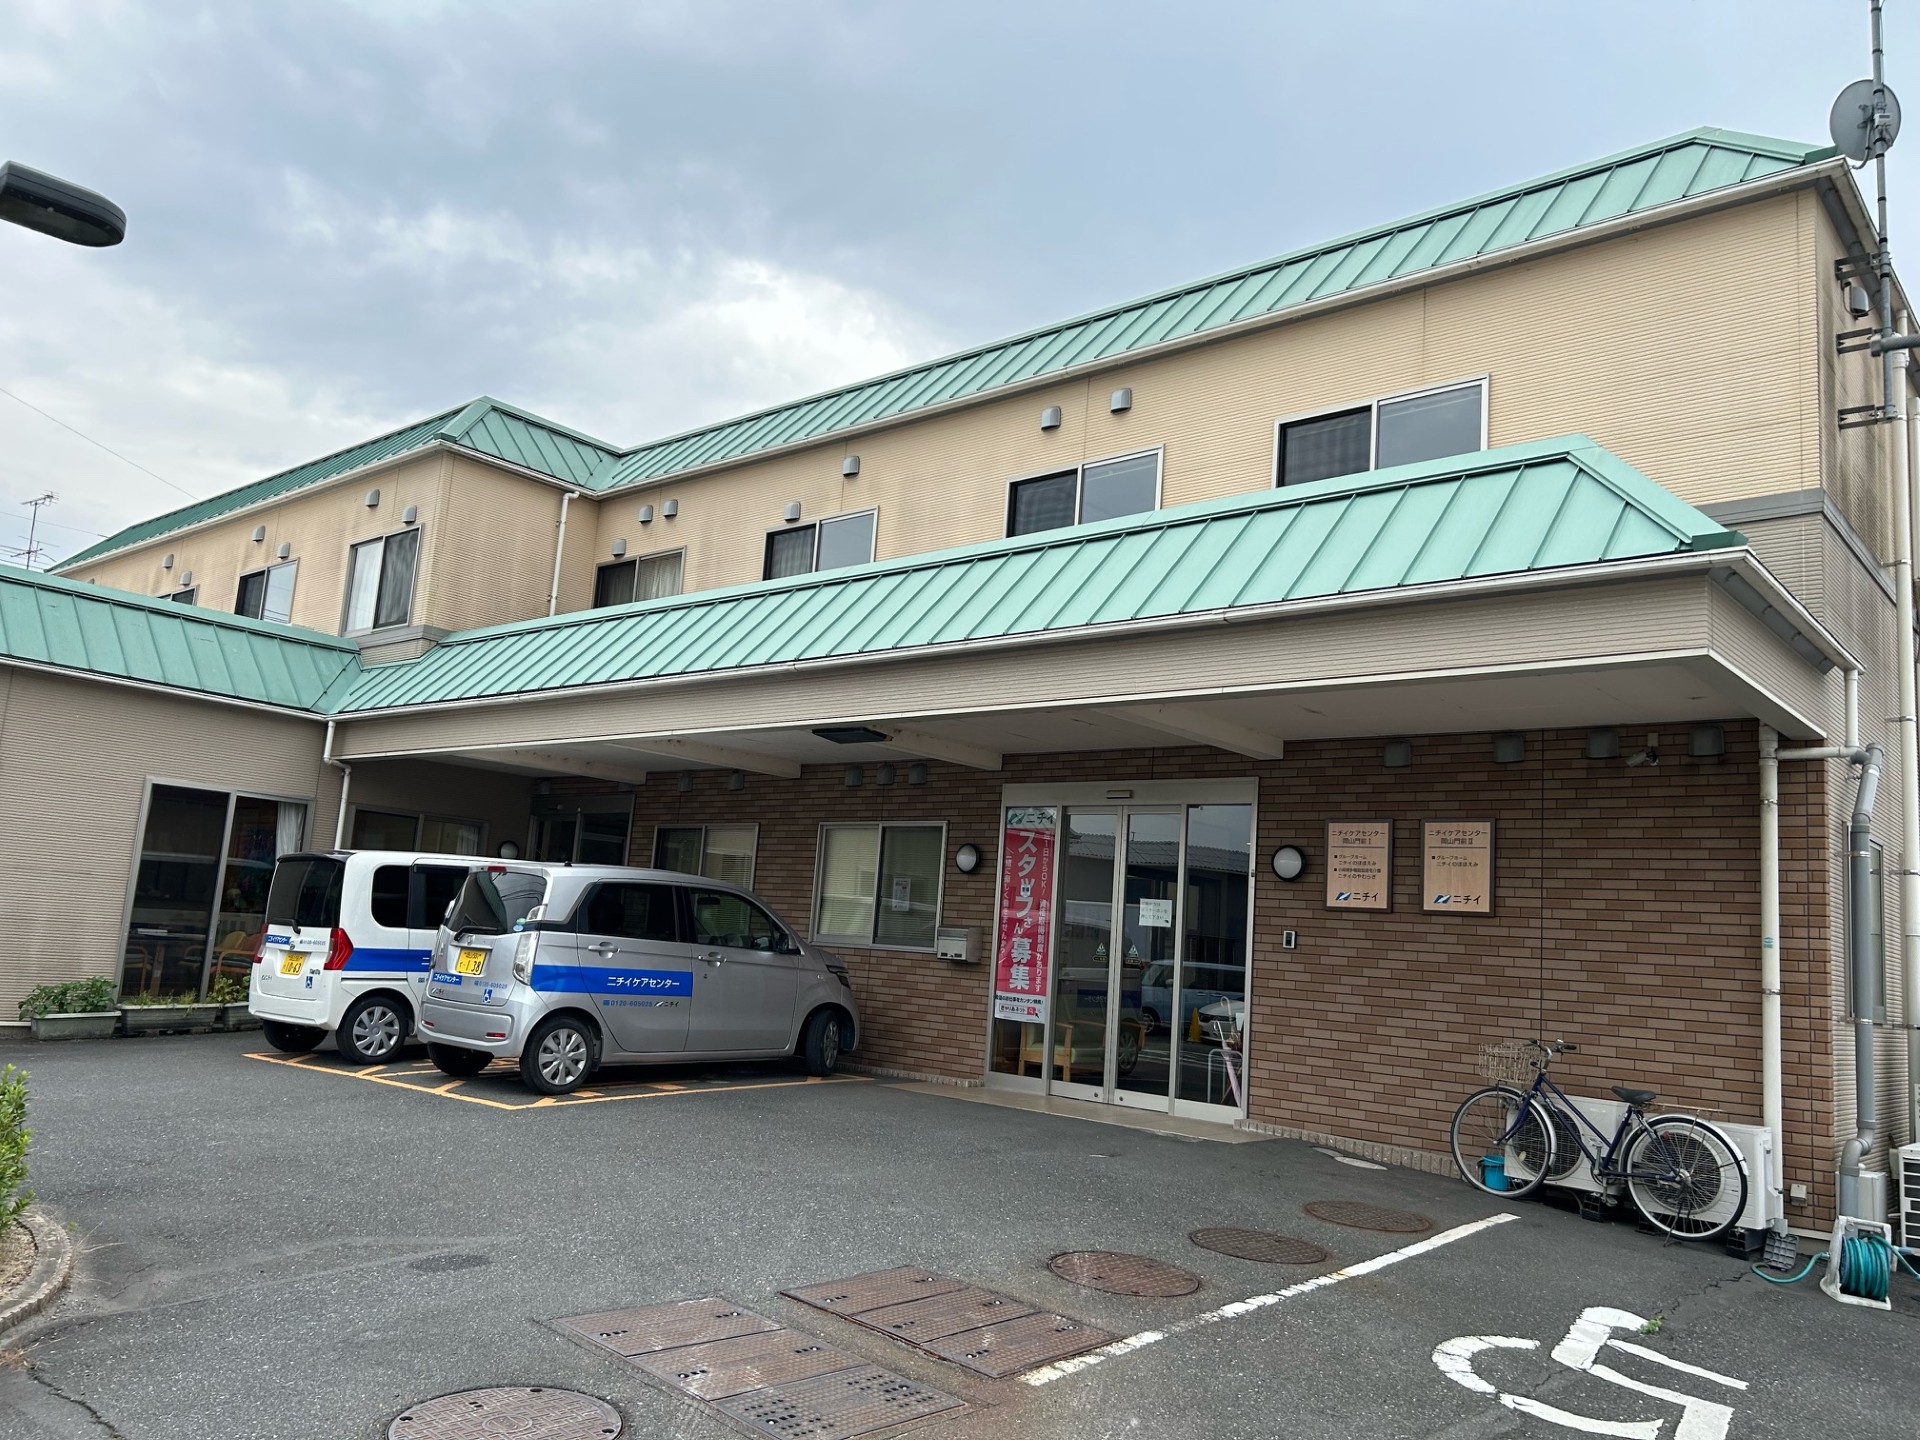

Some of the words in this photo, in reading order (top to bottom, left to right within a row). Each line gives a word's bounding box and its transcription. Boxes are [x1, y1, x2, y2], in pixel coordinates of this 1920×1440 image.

[1026, 812, 1055, 825] ニチイ
[1428, 829, 1488, 837] ニチイケアセンター
[1352, 892, 1379, 902] ニチイ
[1453, 895, 1481, 905] ニチイ
[607, 976, 680, 988] ニチイケアセンター
